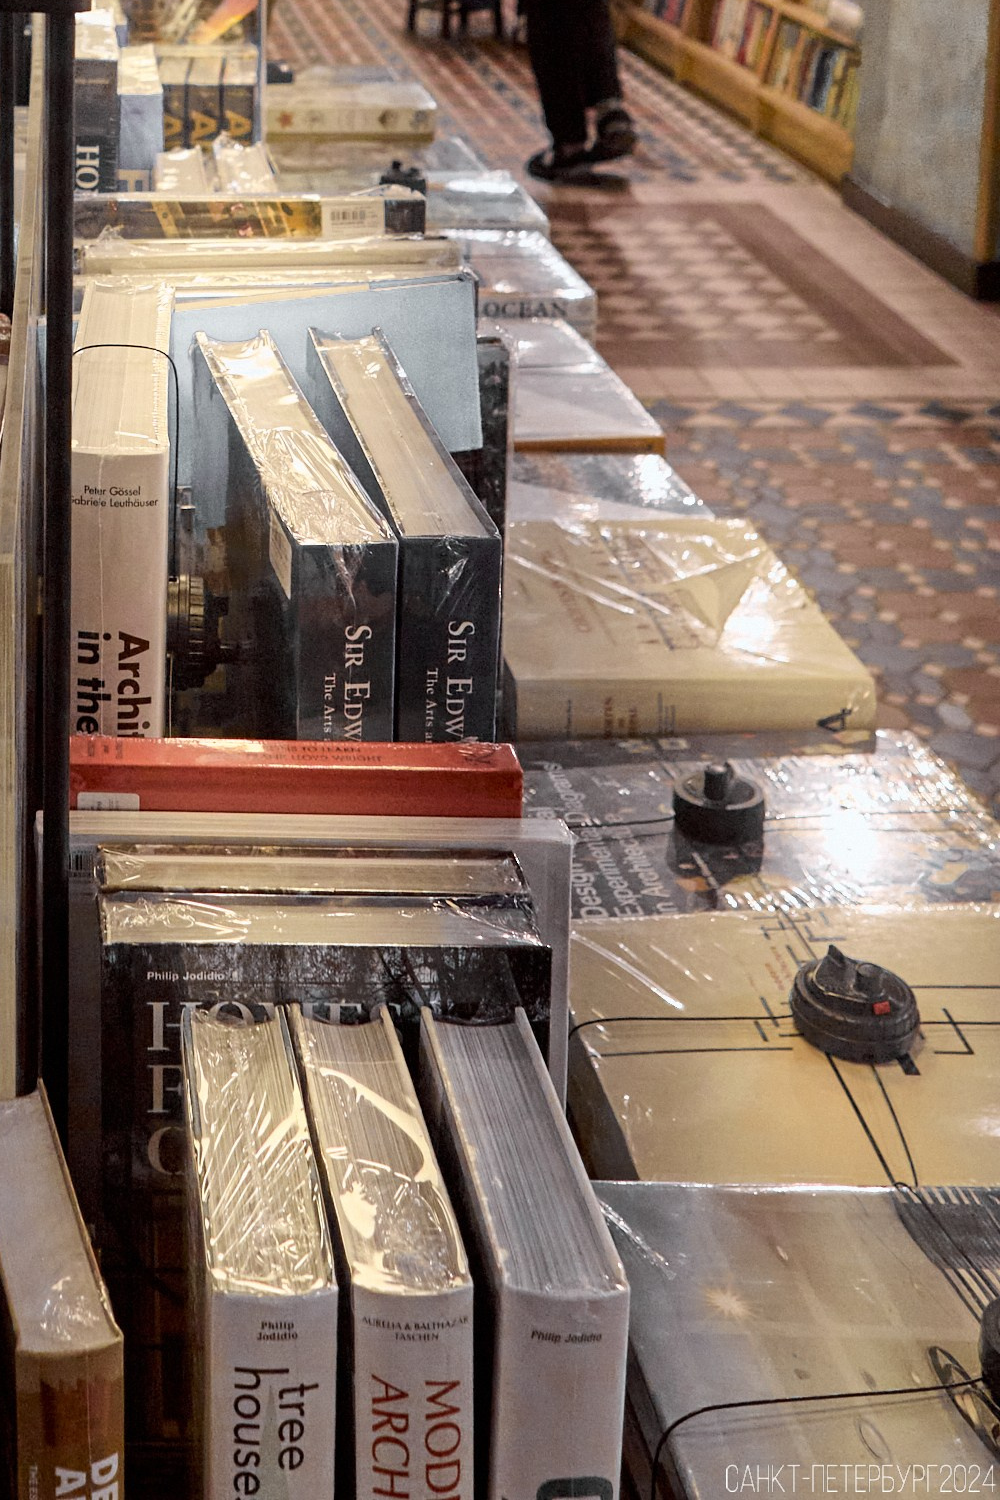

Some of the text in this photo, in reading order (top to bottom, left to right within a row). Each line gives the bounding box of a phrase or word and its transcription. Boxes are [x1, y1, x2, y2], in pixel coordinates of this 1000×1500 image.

[482, 302, 567, 318] OCEAN
[84, 485, 142, 497] Peter Gössel
[110, 495, 159, 508] Leuthäuser
[77, 631, 112, 664] in
[117, 631, 152, 737] Archi
[426, 667, 439, 695] The
[76, 677, 112, 734] the
[323, 672, 336, 733] The Arts
[425, 699, 437, 727] Arts
[146, 970, 226, 983] Philip Jodidio
[256, 1332, 298, 1341] Jodidio
[260, 1321, 295, 1331] Philip
[394, 1332, 440, 1342] TASCHEN
[404, 1323, 411, 1331] &
[530, 1330, 603, 1344] Philip Jodidio
[233, 1366, 289, 1500] house
[278, 1383, 319, 1471] tree
[424, 1380, 462, 1500] MOD
